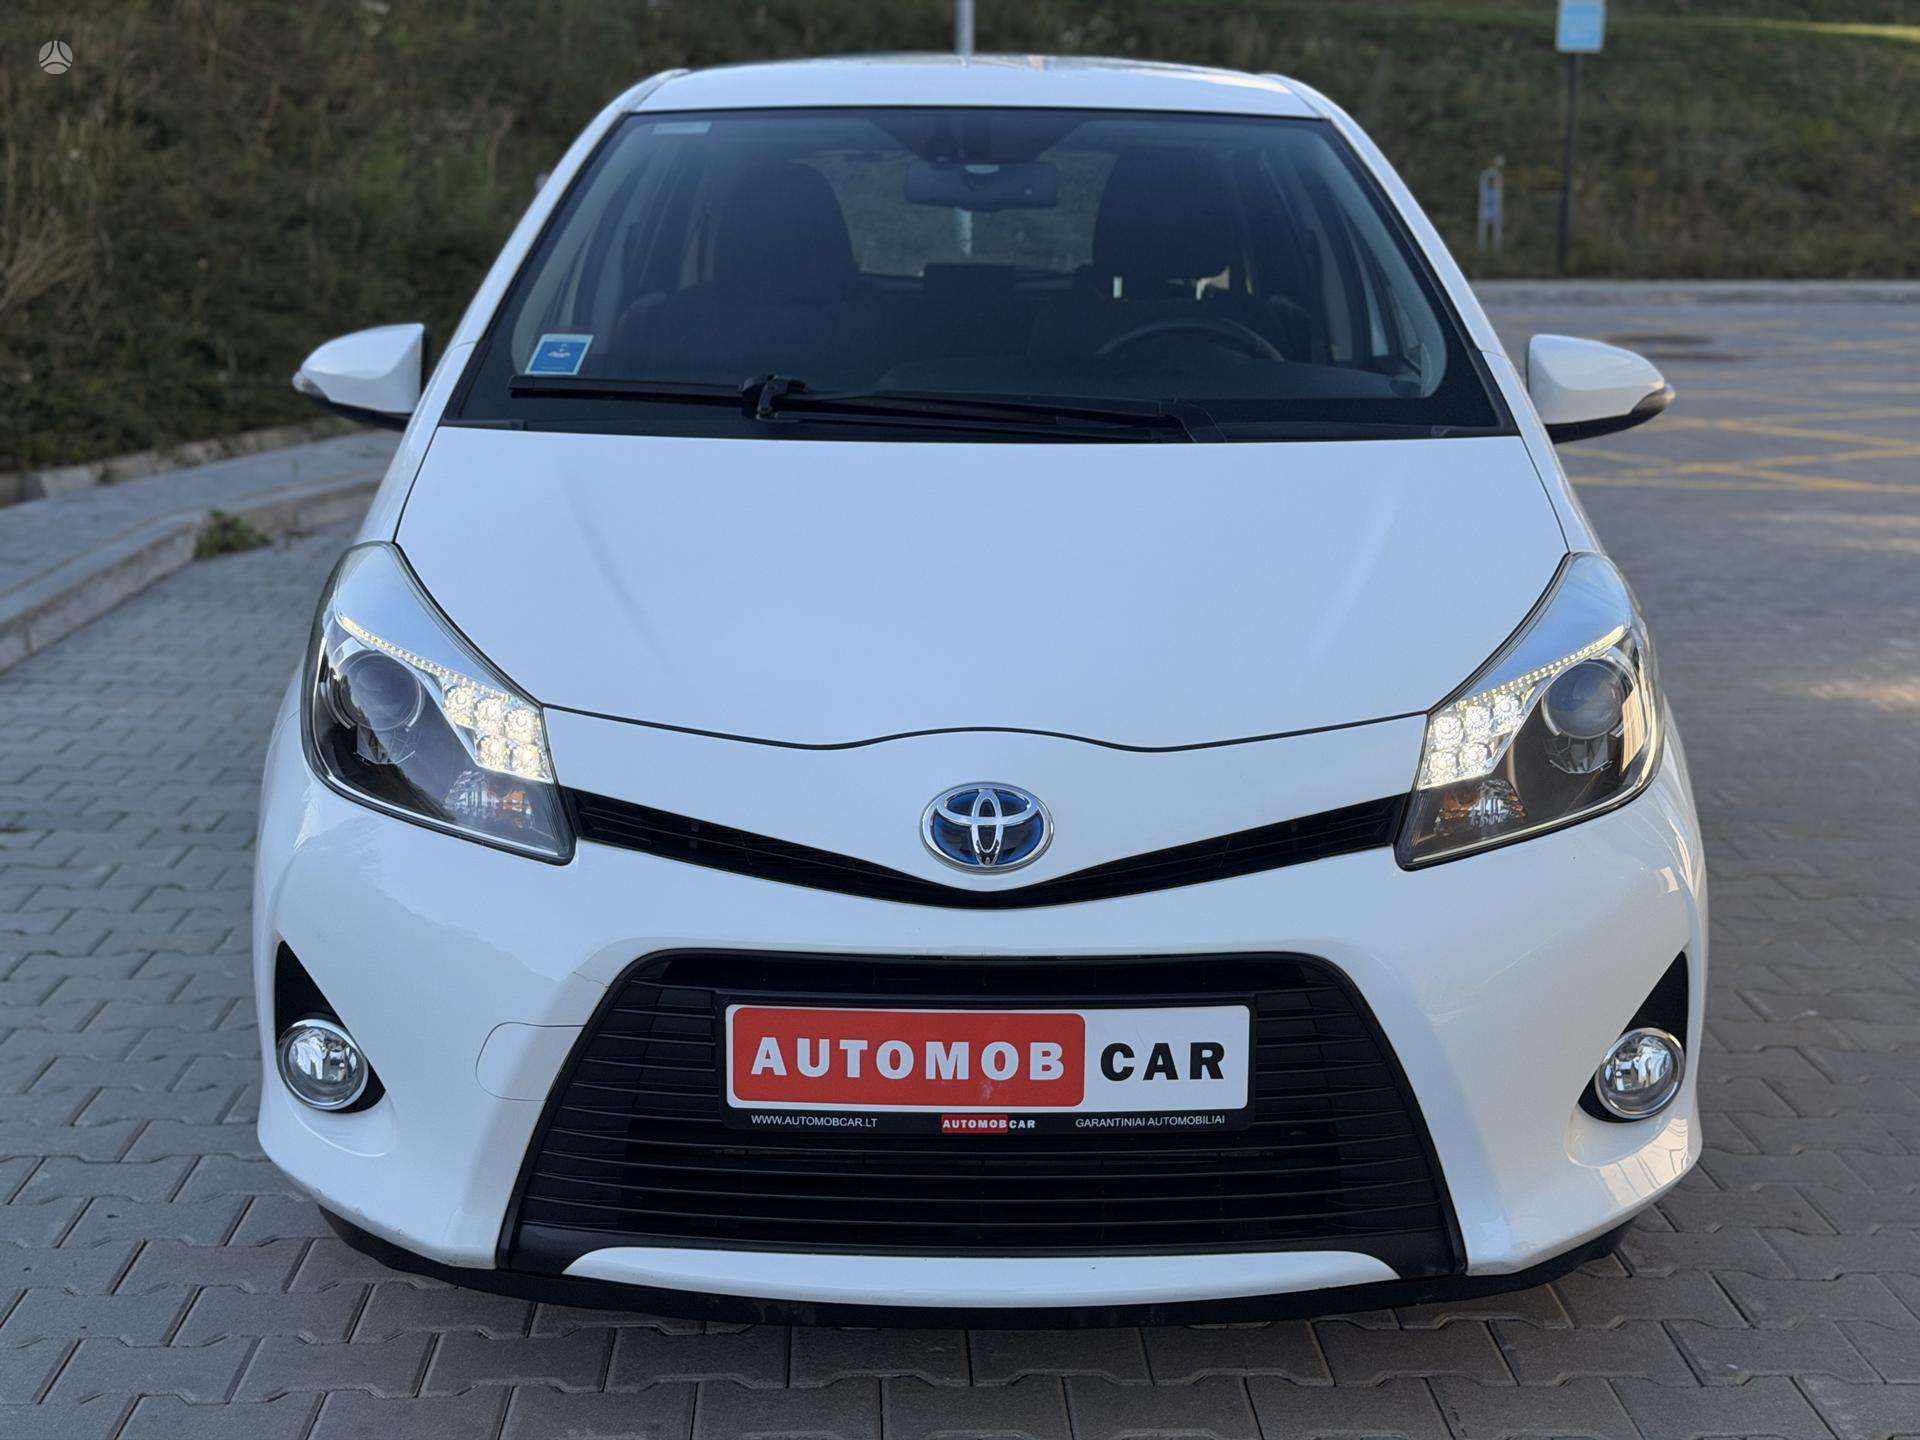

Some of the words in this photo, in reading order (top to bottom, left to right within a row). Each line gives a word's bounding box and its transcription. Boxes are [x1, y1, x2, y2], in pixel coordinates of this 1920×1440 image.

[750, 1036, 1065, 1081] AUTOMOB
[1100, 1041, 1226, 1081] CAR
[751, 1114, 878, 1128] WWW.AUTOMOBCAR.LT
[1075, 1117, 1146, 1128] GARANTINIAI
[1148, 1115, 1225, 1127] AUTOMOBILIAI
